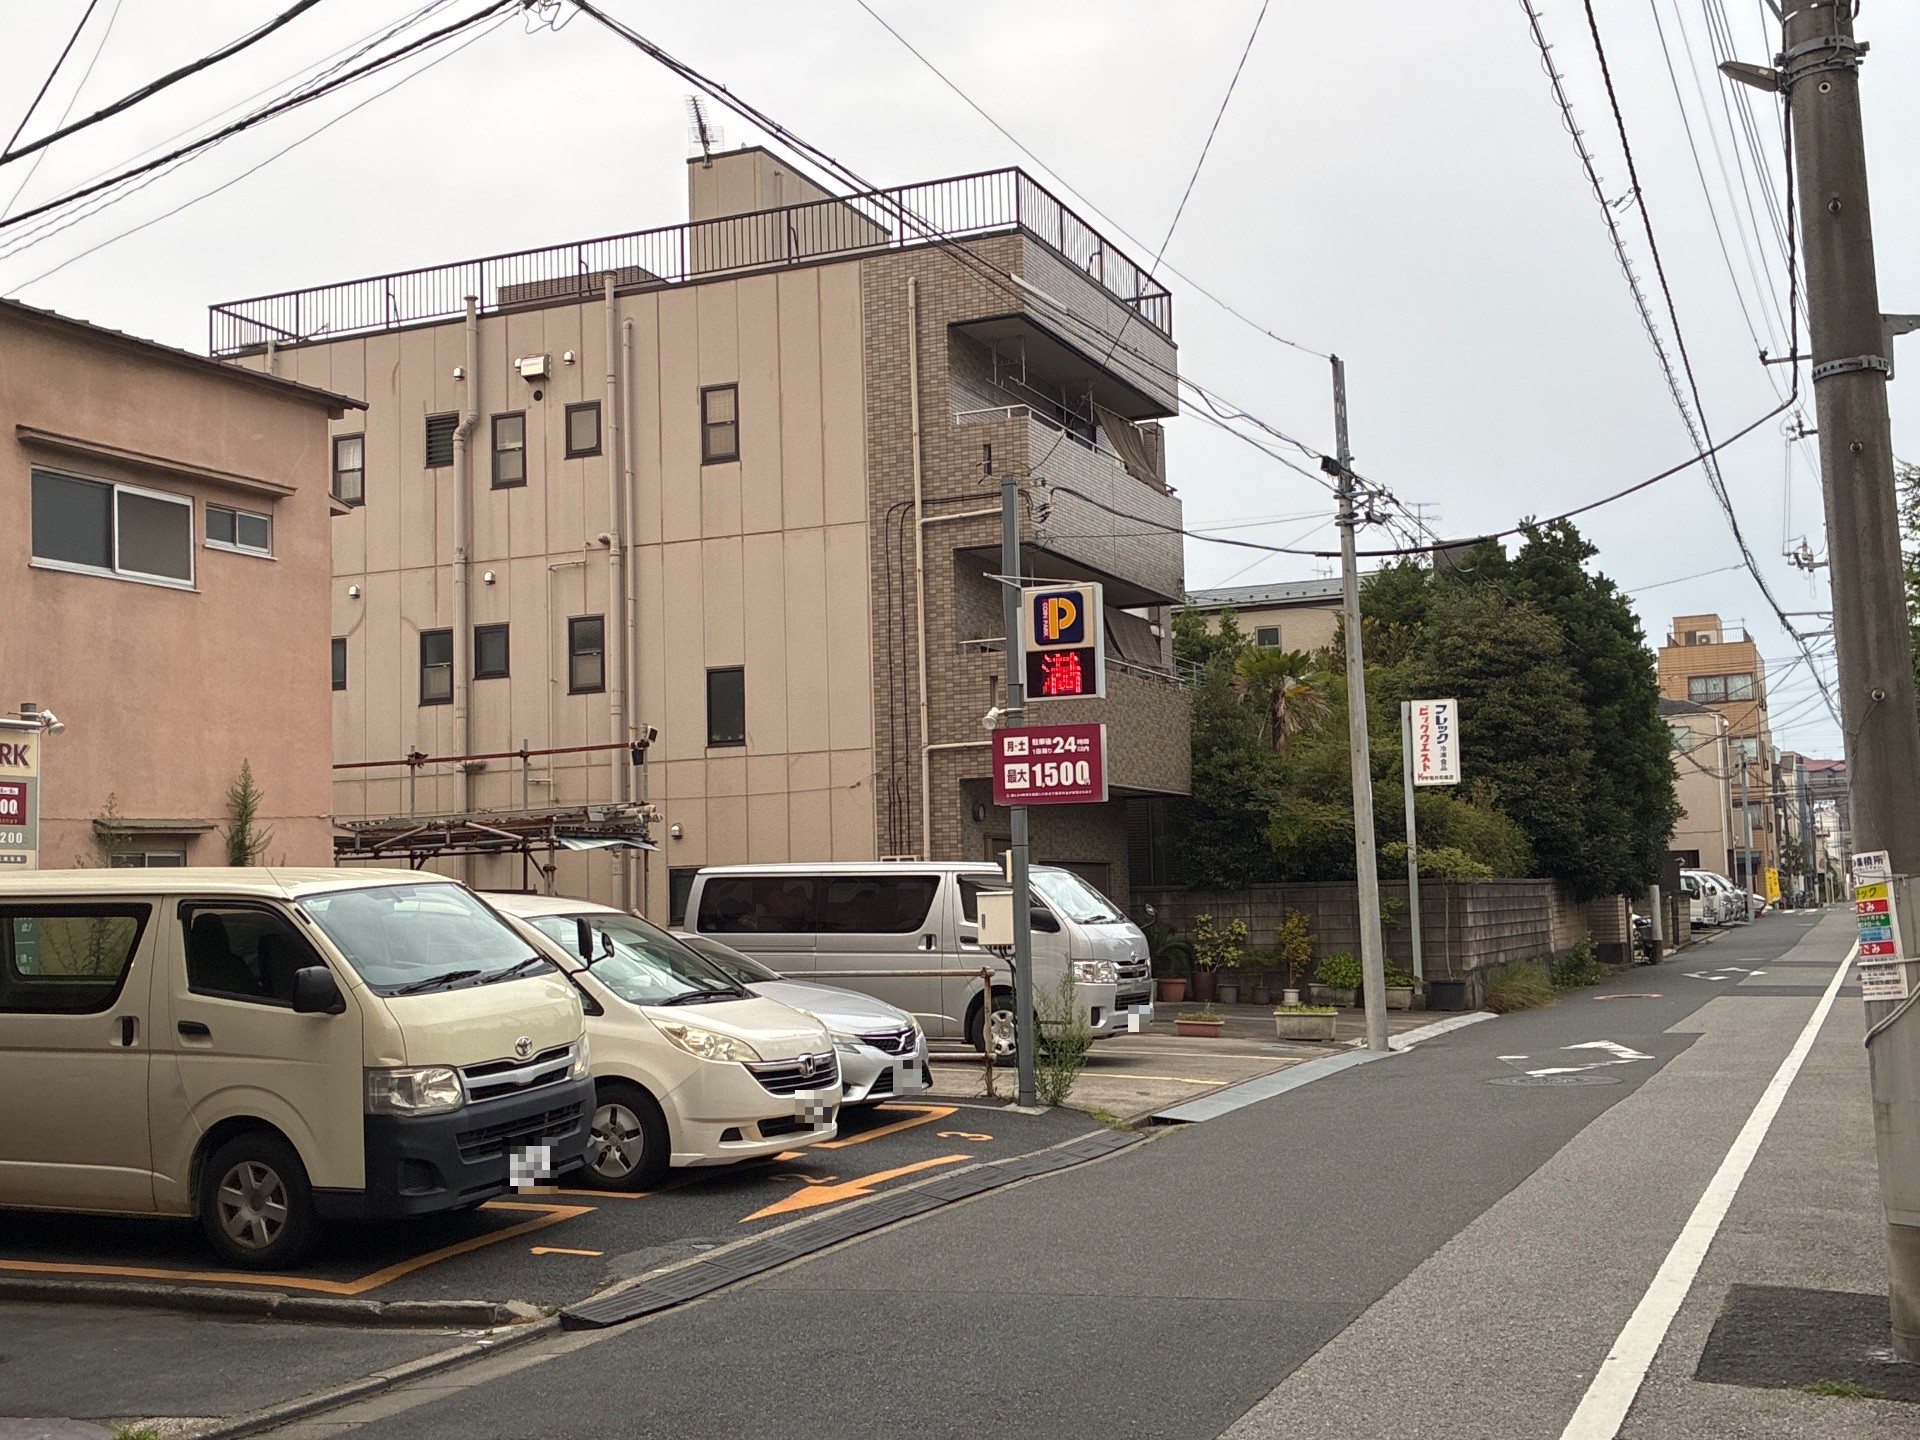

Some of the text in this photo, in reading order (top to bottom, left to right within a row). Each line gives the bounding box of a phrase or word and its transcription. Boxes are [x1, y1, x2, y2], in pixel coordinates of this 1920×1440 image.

[1041, 652, 1082, 695] 満
[1435, 704, 1449, 744] フレック
[1052, 736, 1077, 754] 24
[1007, 769, 1027, 783] 最大
